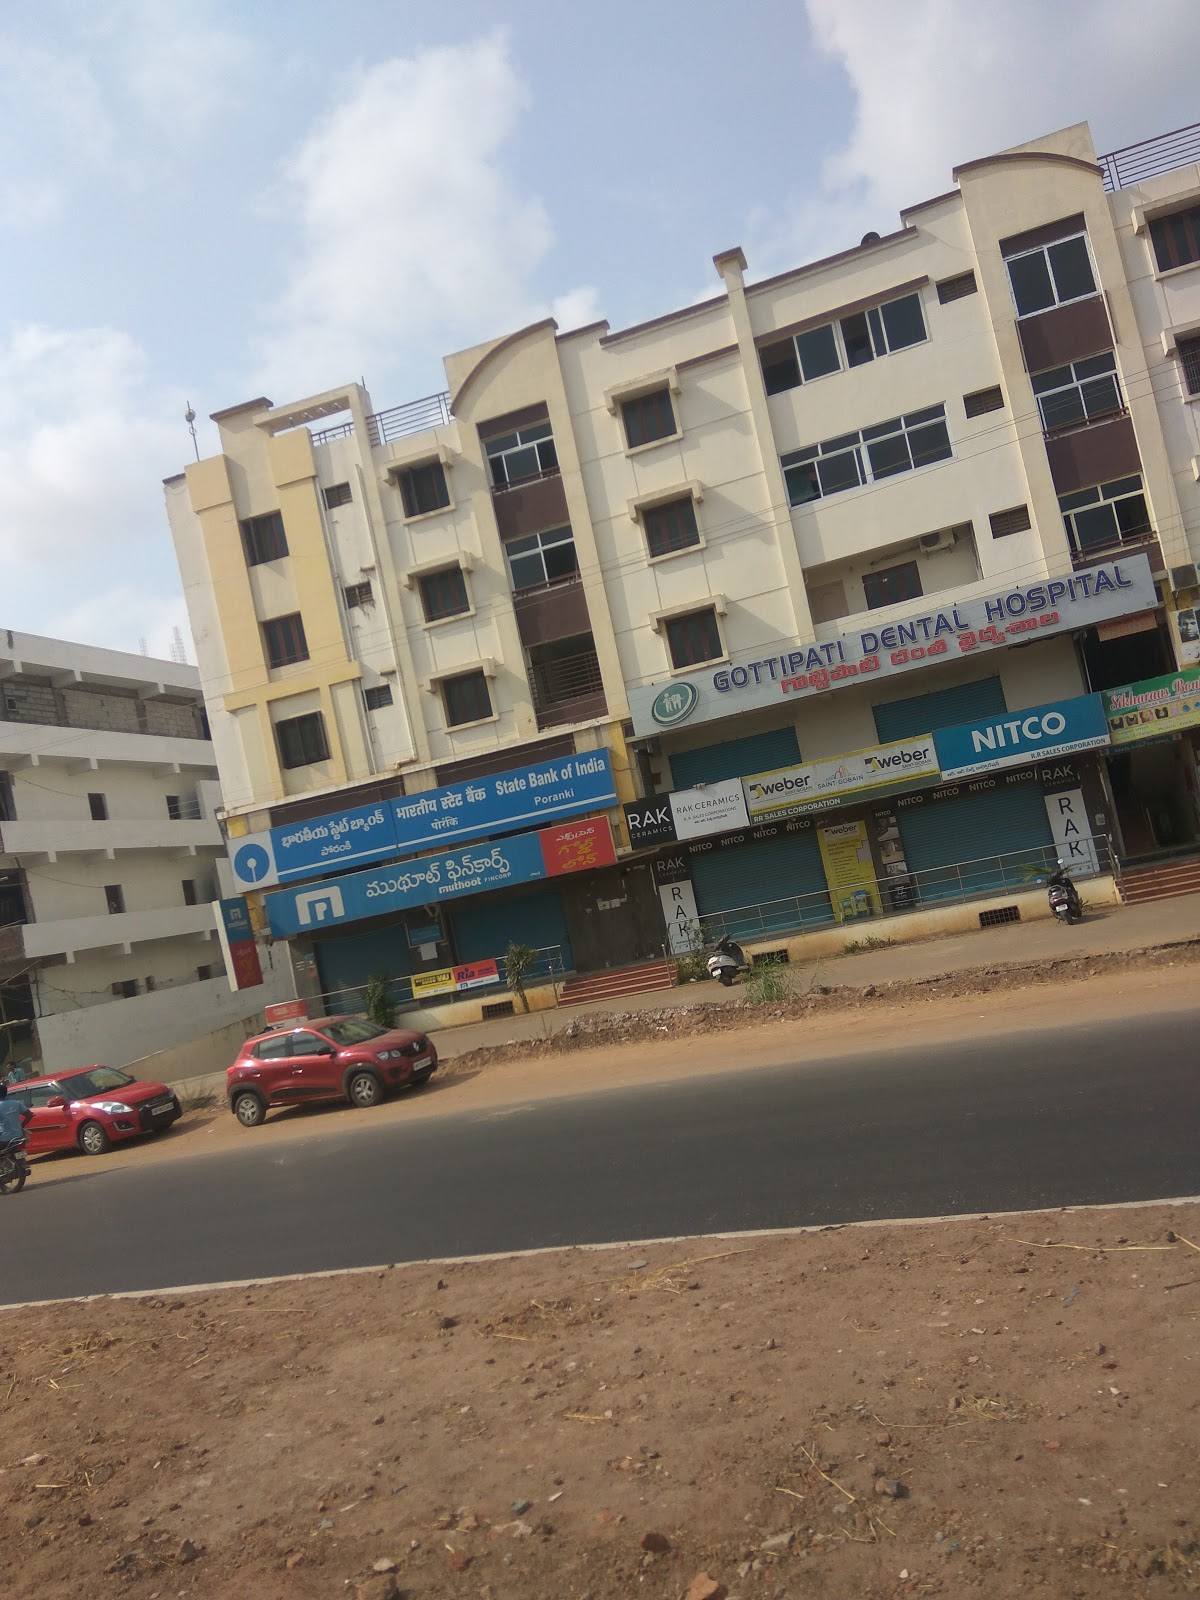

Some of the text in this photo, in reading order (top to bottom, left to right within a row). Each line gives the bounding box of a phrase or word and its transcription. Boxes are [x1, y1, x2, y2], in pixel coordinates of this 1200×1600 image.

[713, 565, 1133, 692] GOTTIPATI DENTAL HOSPITAL
[1109, 688, 1171, 711] Sikharaas
[971, 711, 1066, 753] NITCO
[1042, 747, 1062, 757] SALES
[1062, 738, 1106, 752] CORPORATION
[877, 747, 929, 769] weber
[495, 757, 606, 796] State Bank of India
[817, 774, 864, 790] SAINT-GOBAIN
[1006, 770, 1033, 784] NITCO
[1041, 764, 1074, 782] RAK
[763, 774, 811, 796] weber
[932, 787, 960, 800] NITCO
[968, 778, 996, 792] NITCO
[396, 785, 487, 820] भारतीय स्टेट बैंक
[534, 788, 575, 806] Poranki
[676, 801, 694, 814] RAK
[694, 793, 740, 810] CERAMICS
[897, 795, 924, 807] NITCO
[627, 806, 671, 830] RAK
[754, 815, 764, 823] RR
[764, 810, 787, 821] SALES
[788, 798, 841, 816] CORPORATION
[281, 823, 329, 849] భారతీయ
[350, 808, 385, 832] బ్యాంక్
[631, 825, 673, 840] CERAMICS
[753, 827, 778, 839] NITCO
[786, 819, 811, 832] NITCO
[831, 823, 857, 835] weber
[1058, 796, 1085, 858] RAK
[689, 841, 713, 853] NITCO
[720, 834, 745, 847] NITCO
[656, 856, 685, 872] RAK
[438, 871, 512, 894] muthoot FINCORP
[457, 967, 475, 981] Ria
